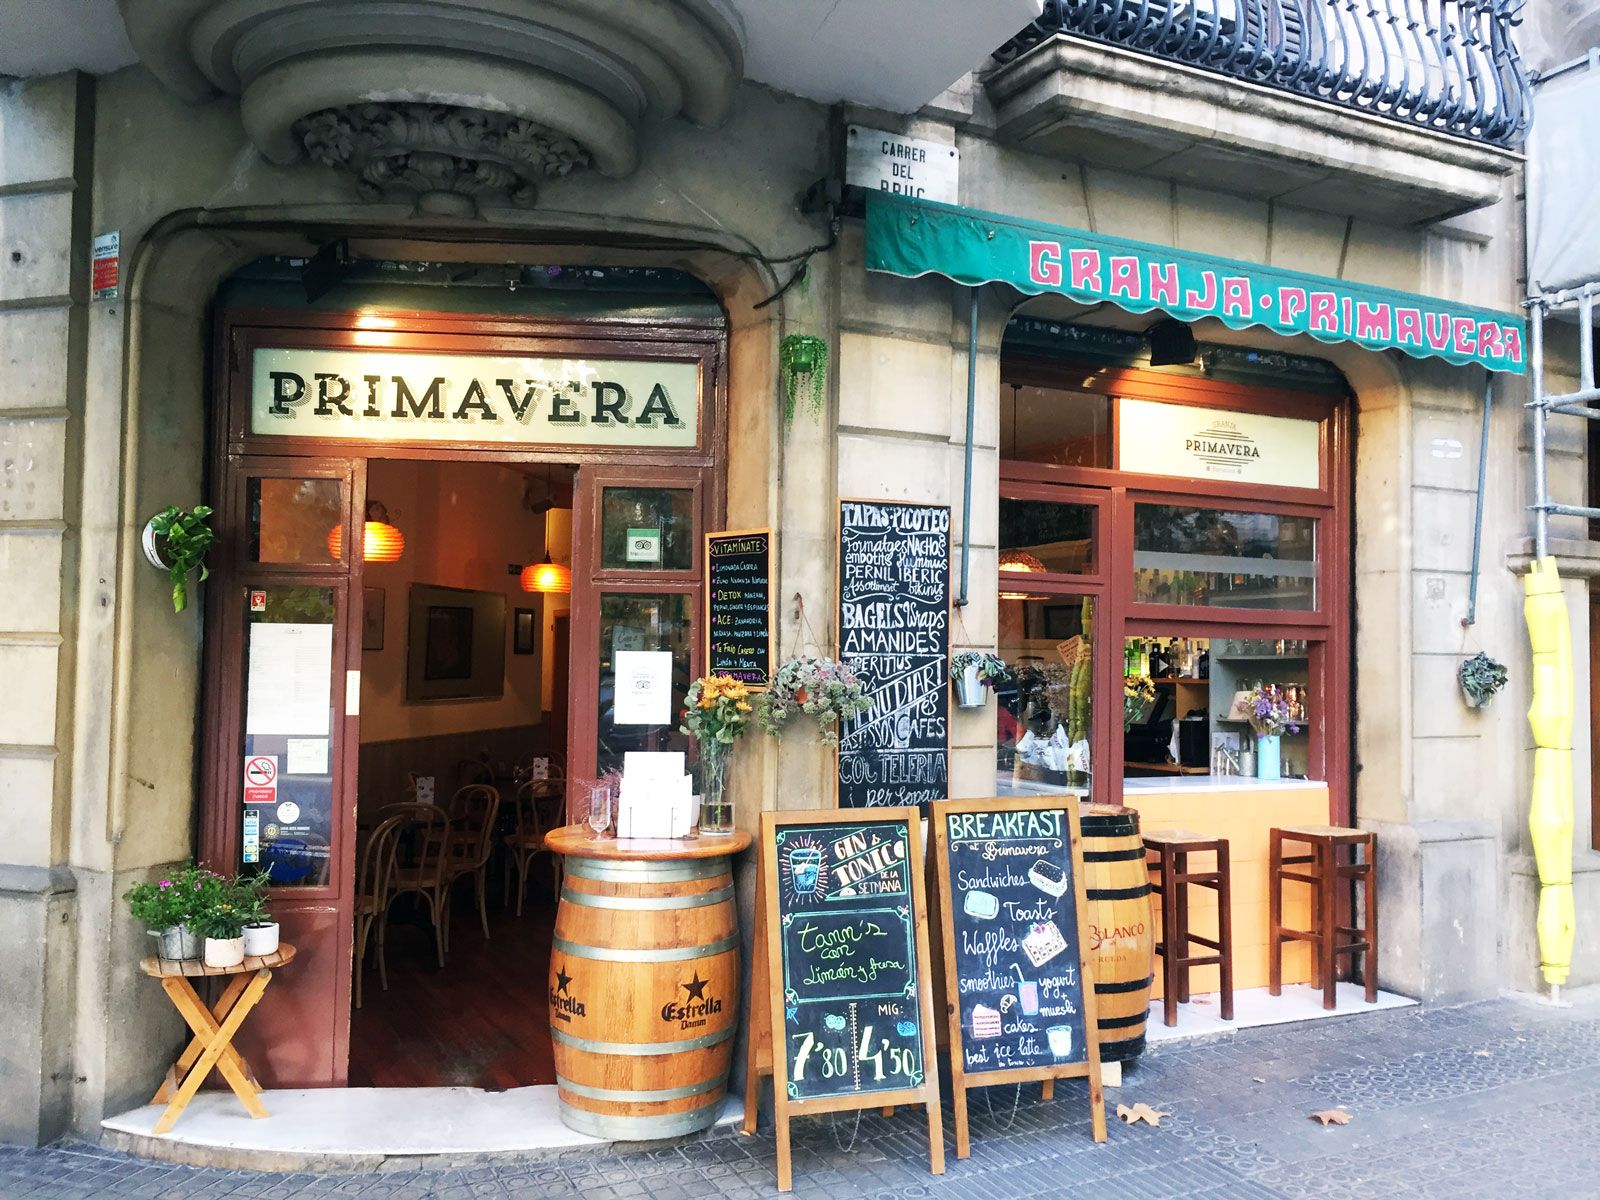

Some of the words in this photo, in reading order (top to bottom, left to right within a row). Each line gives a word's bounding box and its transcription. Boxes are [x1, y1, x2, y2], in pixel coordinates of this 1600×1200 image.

[882, 141, 926, 163] CARRER
[892, 163, 914, 180] DEL
[1029, 240, 1252, 318] GRANJA
[1278, 286, 1522, 363] PRIMAVERA
[268, 371, 685, 428] PRIMAVERA
[1185, 439, 1260, 458] PRIMAVERA
[842, 503, 890, 528] TAPAS
[892, 507, 949, 533] PICOTEO
[713, 539, 761, 555] VITAMÍNATE
[907, 535, 946, 557] NACHOS
[845, 565, 895, 581] PERNIL
[899, 568, 943, 584] IBERIC
[717, 590, 741, 601] DETOX
[908, 582, 945, 596] bikinis
[842, 602, 904, 629] BAGELS
[903, 601, 948, 633] Wraps
[844, 629, 941, 654] AMANIDES
[865, 788, 895, 808] per
[949, 810, 1065, 839] BREAKFAST
[834, 832, 867, 860] GIN
[831, 842, 897, 887] TONIC
[880, 871, 889, 879] DE
[889, 870, 898, 878] LA
[858, 879, 902, 894] SETMANA
[957, 864, 1030, 891] Sandwiches
[1003, 898, 1058, 922] Toasts
[962, 927, 1019, 968] Waffles
[960, 968, 1017, 994] smoothies
[1038, 966, 1076, 999] yogurt
[661, 997, 722, 1022] Estrella
[1040, 1001, 1077, 1017] muesli
[681, 1018, 707, 1030] Damm
[792, 1031, 847, 1082] 7'80
[858, 1025, 916, 1081] 4'50
[965, 1044, 989, 1065] best
[993, 1043, 1015, 1059] ice
